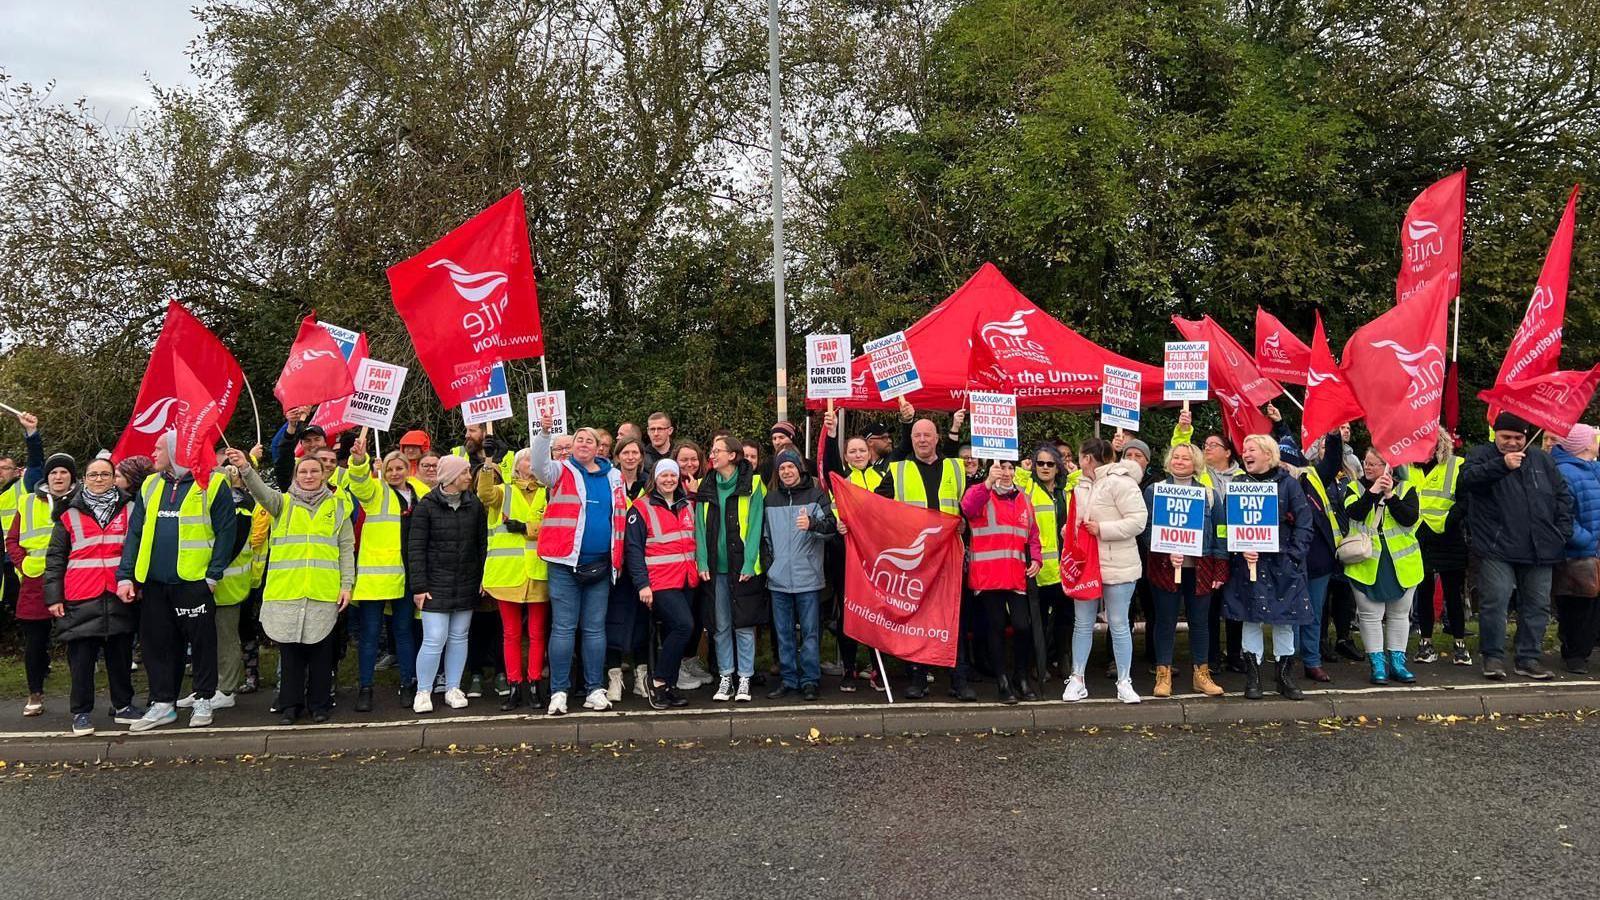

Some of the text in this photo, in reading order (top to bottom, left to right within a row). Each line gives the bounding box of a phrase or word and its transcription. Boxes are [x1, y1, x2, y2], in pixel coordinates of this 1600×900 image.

[817, 341, 838, 351] FAIR
[866, 334, 902, 351] BAKKAVOR
[821, 352, 837, 363] PAY
[871, 343, 901, 362] FAIR PAY
[1170, 352, 1203, 360] FAIR PAY
[873, 352, 909, 371] FOR FOOD
[1168, 362, 1205, 370] FOR FOOD
[369, 368, 392, 379] FAIR
[811, 367, 846, 375] FOR FOOD
[876, 362, 912, 379] WORKERS
[1018, 370, 1044, 383] the
[368, 380, 388, 391] PAY
[811, 376, 847, 384] WORKERS
[887, 374, 908, 388] NOW!
[1108, 376, 1136, 390] FAIR PAY
[353, 391, 391, 407] FOR FOOD
[1105, 386, 1137, 399] FOR FOOD
[470, 397, 503, 414] NOW!
[972, 395, 1012, 404] BAKKAVOR
[1105, 395, 1137, 409] WORKERS
[350, 400, 389, 416] WORKERS
[976, 404, 1010, 416] FAIR PAY
[1111, 406, 1129, 418] NOW!
[974, 416, 1013, 426] FOR FOOD
[974, 427, 1014, 437] WORKERS
[983, 438, 1005, 447] NOW!
[1157, 486, 1201, 497] BAKKAVOR
[1229, 485, 1274, 493] BAKKAVOR
[1166, 498, 1192, 513] PAY
[1240, 496, 1265, 510] PAY
[1169, 513, 1188, 526] UP
[1244, 511, 1262, 524] UP
[1160, 528, 1195, 544] NOW!
[1236, 527, 1271, 540] NOW!
